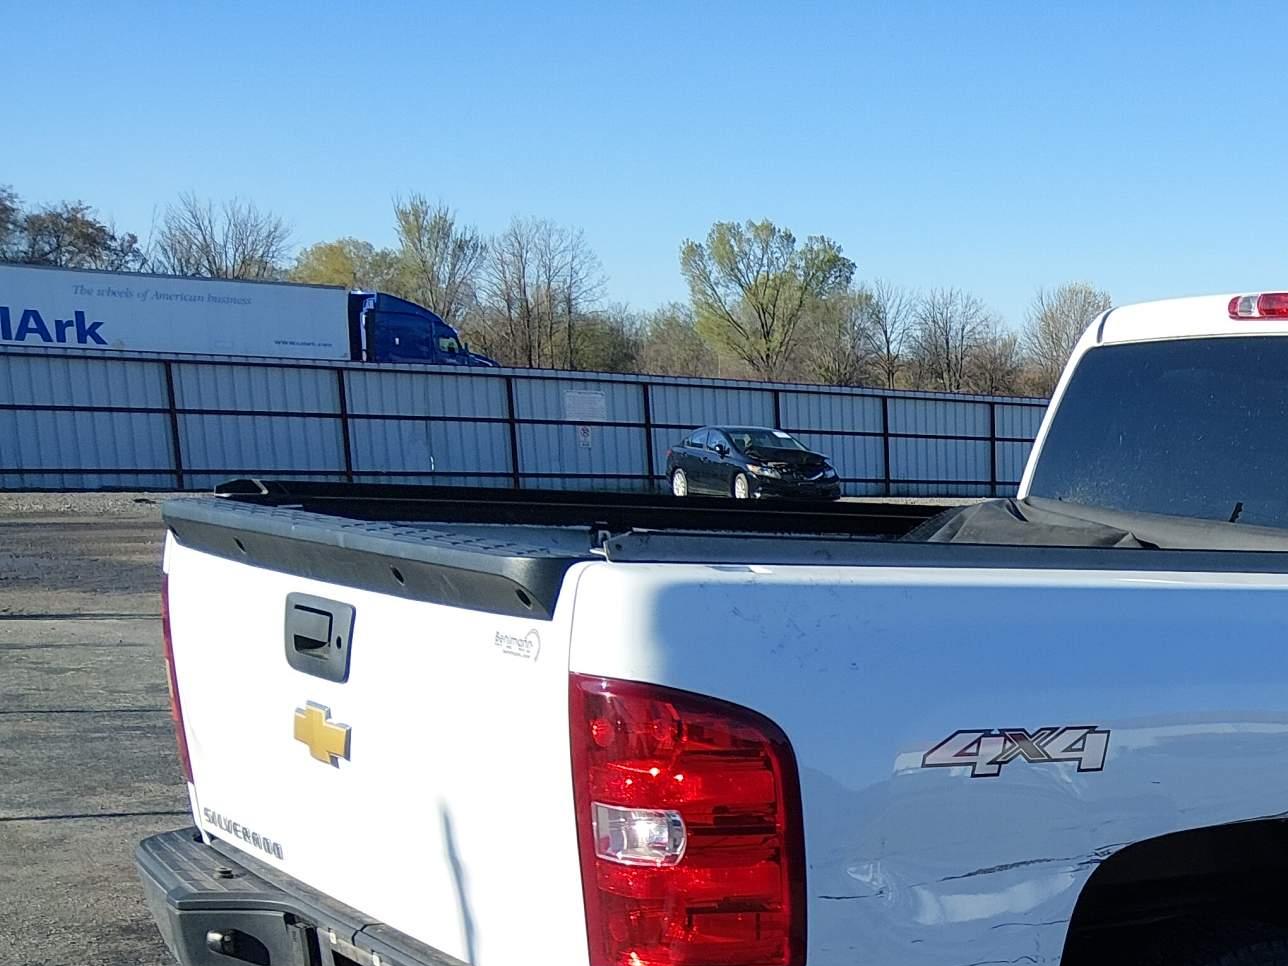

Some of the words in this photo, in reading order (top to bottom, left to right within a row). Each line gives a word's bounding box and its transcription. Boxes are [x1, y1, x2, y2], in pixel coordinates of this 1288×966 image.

[152, 289, 204, 303] American
[207, 293, 252, 304] business
[203, 807, 284, 861] SILVERADO
